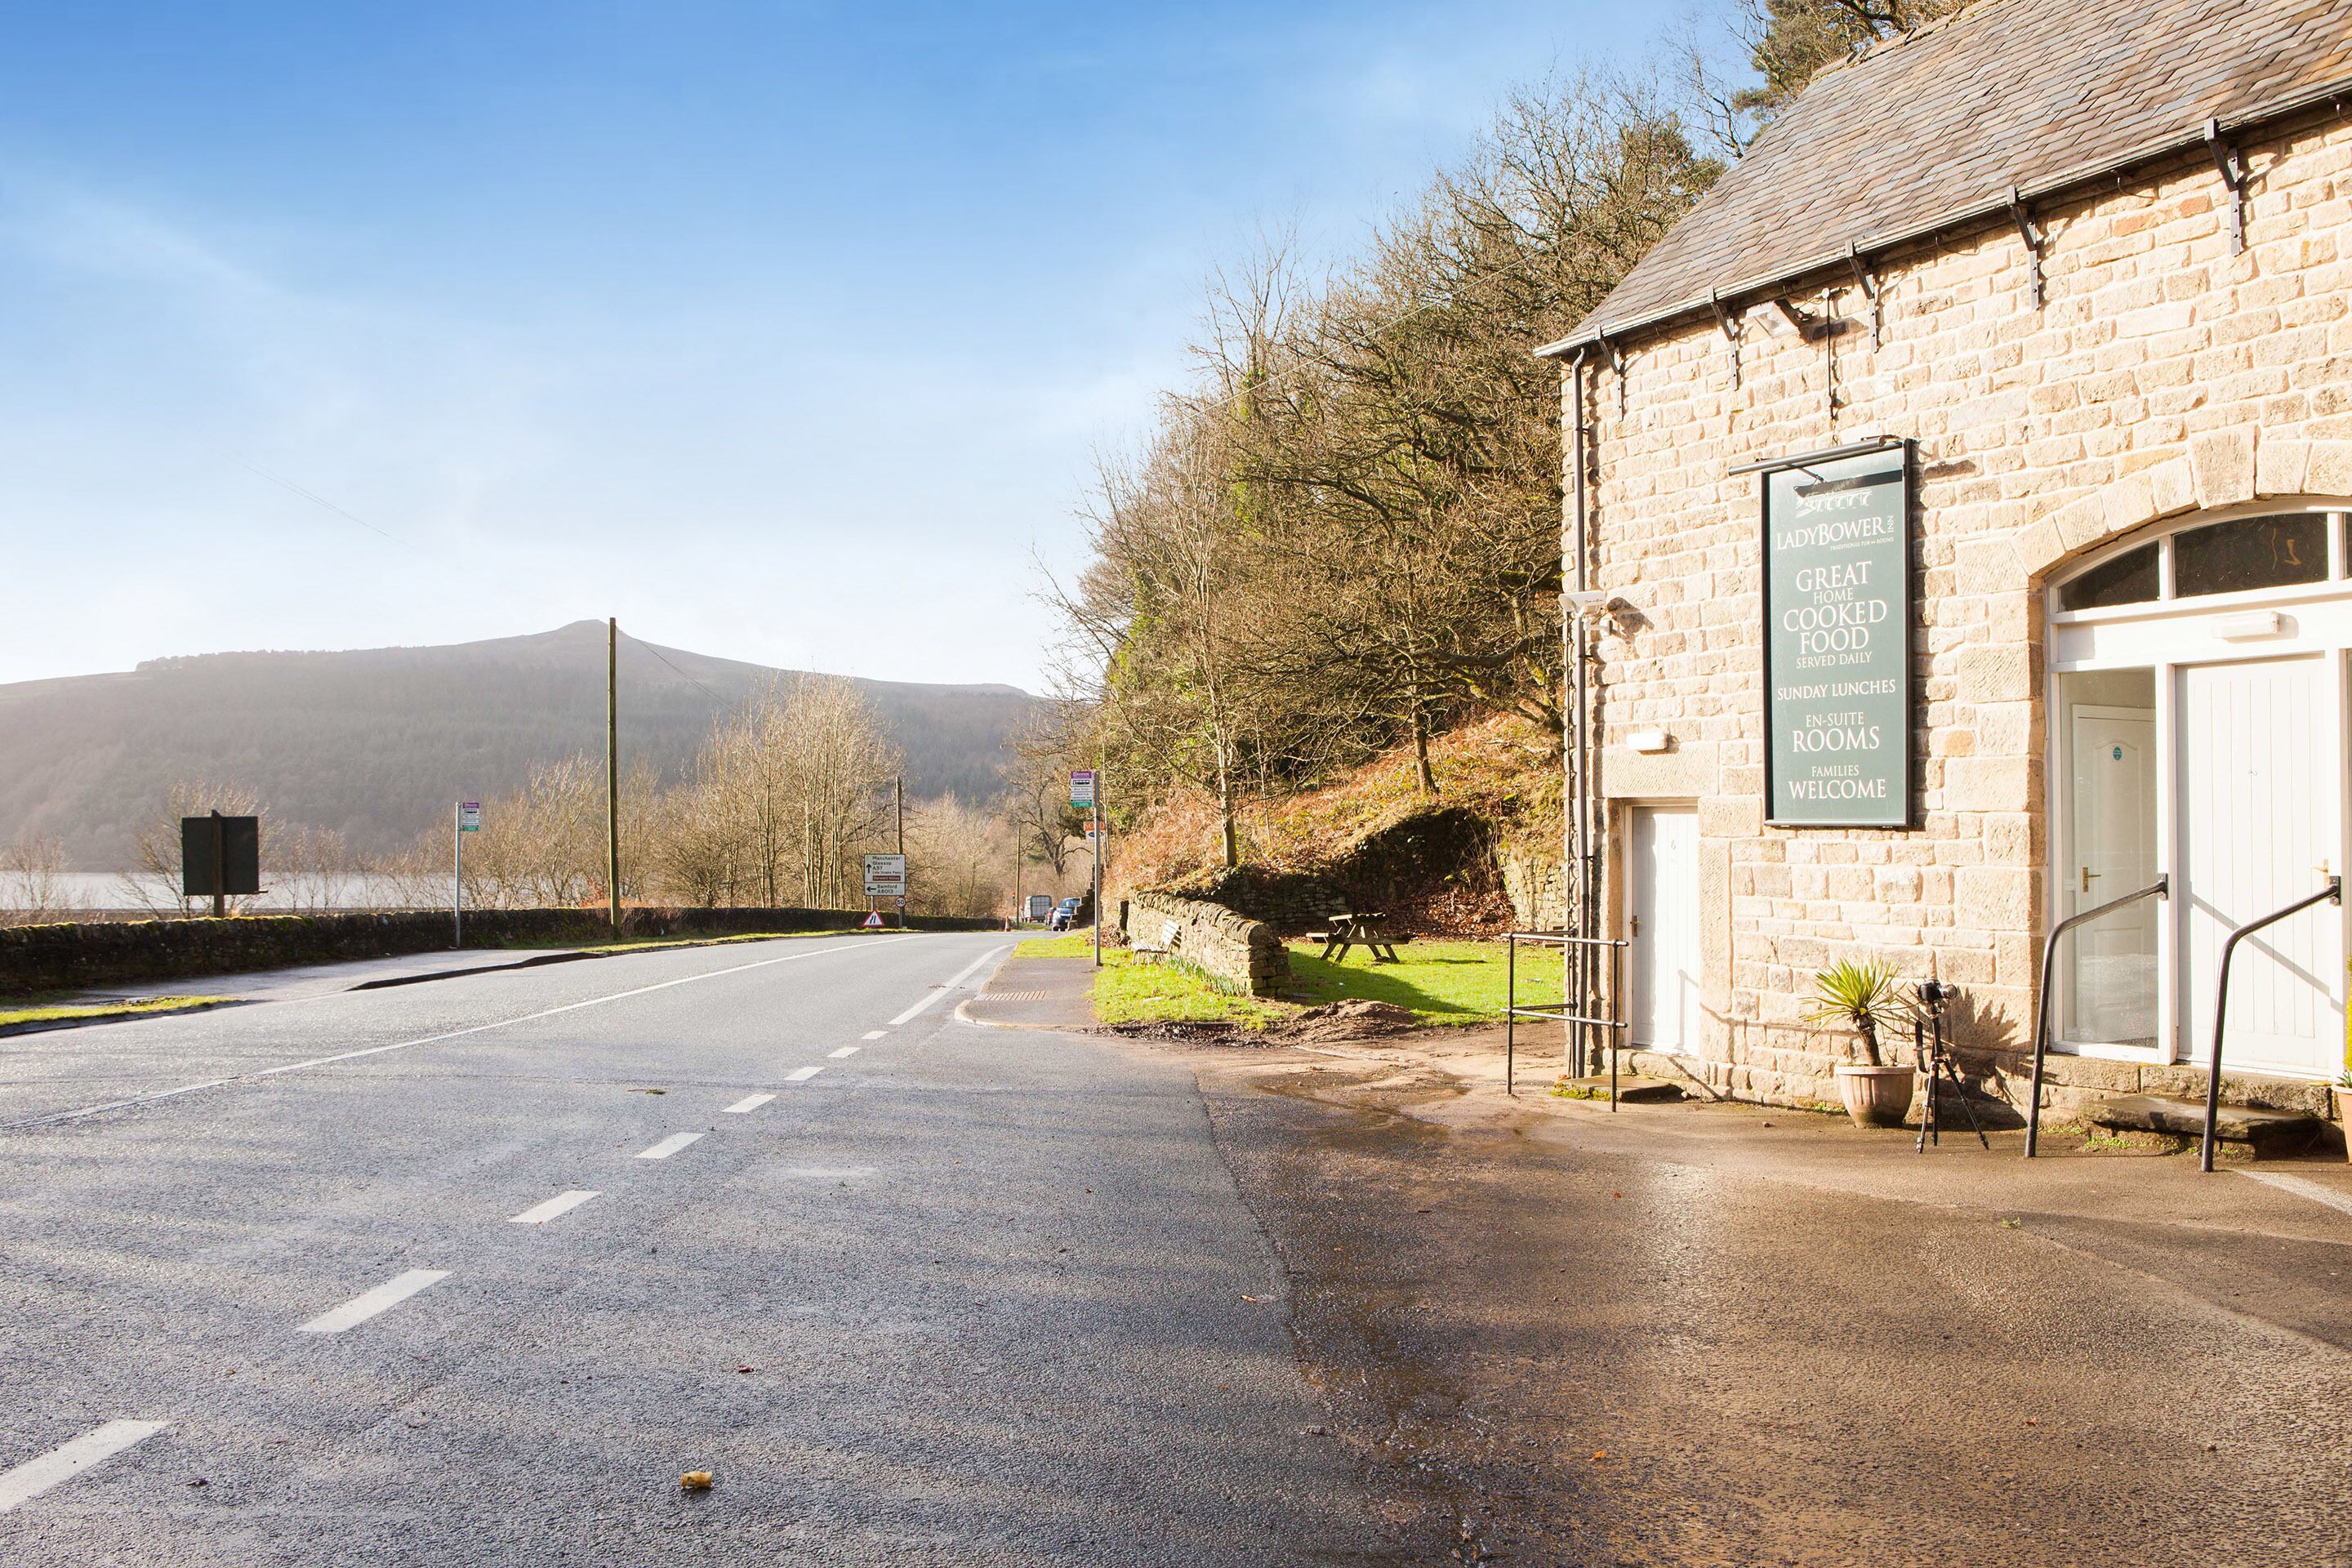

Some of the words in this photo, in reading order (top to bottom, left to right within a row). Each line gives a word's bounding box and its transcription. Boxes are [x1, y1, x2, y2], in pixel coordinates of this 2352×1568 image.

[1776, 516, 1886, 550] LADYBOWER
[1796, 560, 1873, 592] GREAT
[1813, 587, 1854, 605] HOME
[1783, 599, 1887, 632] COOKED
[1799, 626, 1869, 654] FOOD
[1796, 654, 1836, 669] SERVED
[1839, 651, 1873, 666] DAILY
[1777, 684, 1829, 701] SUNDAY
[1832, 679, 1896, 697] LUNCHES
[1806, 711, 1864, 728] EN-SUITE
[1792, 726, 1880, 752] ROOMS
[1811, 764, 1860, 777] FAMILIES
[1788, 778, 1886, 800] WELCOME
